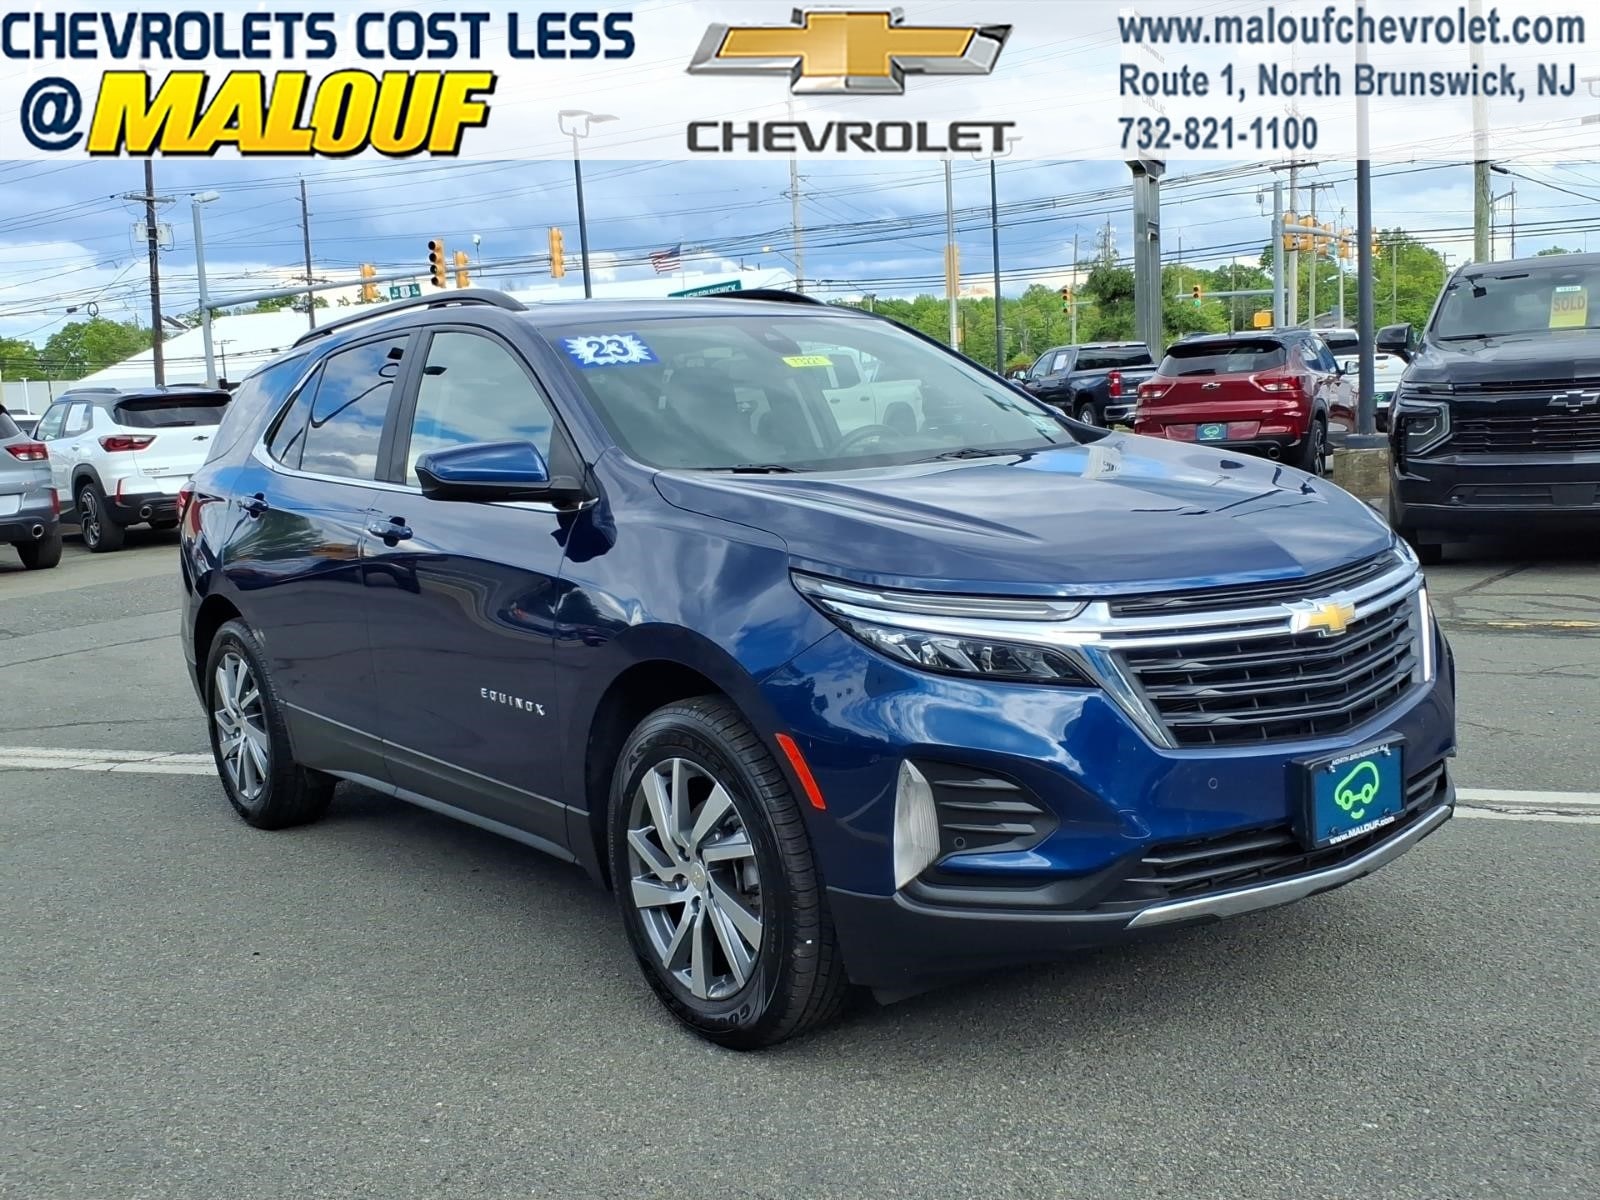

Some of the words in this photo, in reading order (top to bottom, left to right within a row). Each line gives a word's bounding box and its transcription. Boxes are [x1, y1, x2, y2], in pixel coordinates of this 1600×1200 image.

[1553, 295, 1586, 312] SOLD
[586, 340, 629, 358] 23
[481, 687, 545, 716] EQUINOX
